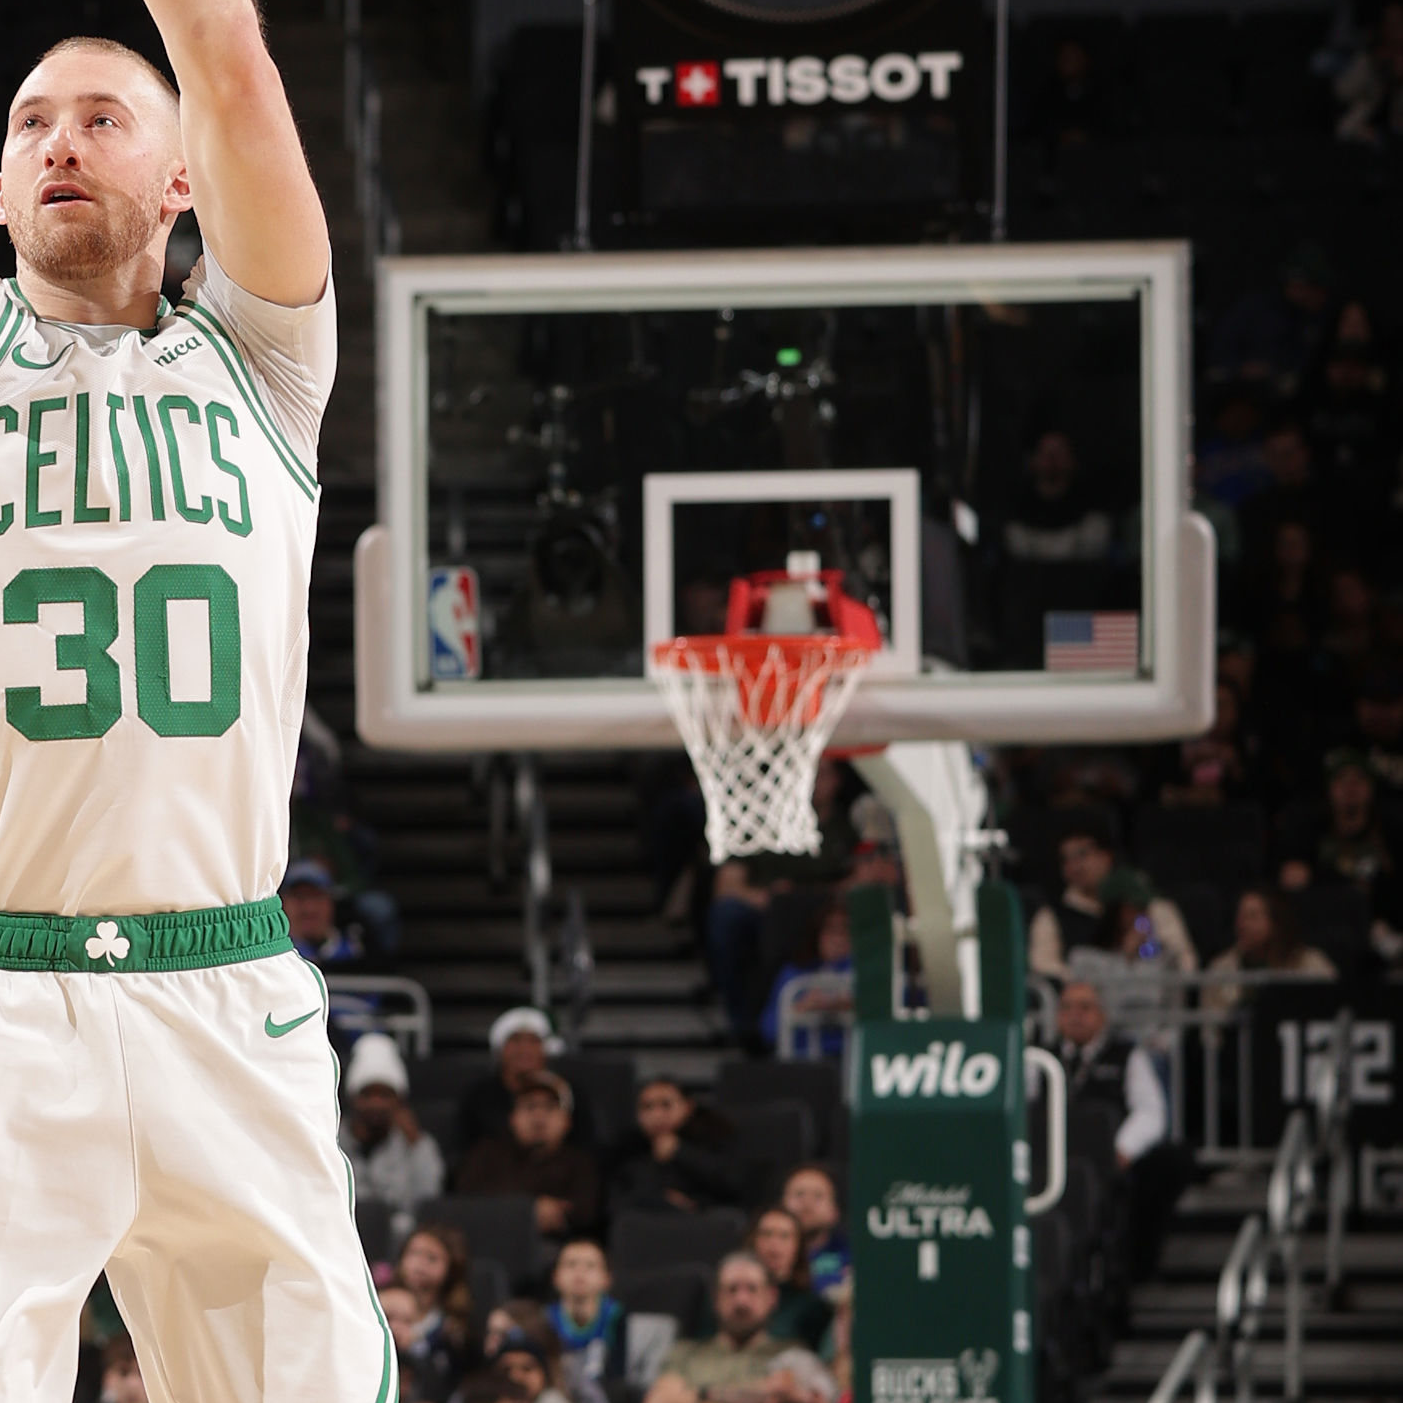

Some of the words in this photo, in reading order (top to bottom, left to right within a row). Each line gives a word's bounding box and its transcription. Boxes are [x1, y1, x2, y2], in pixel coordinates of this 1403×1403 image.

[724, 51, 963, 106] TISSOT
[3, 564, 242, 741] 30
[870, 1040, 1001, 1097] wilo
[867, 1205, 994, 1240] ULTRA
[871, 1365, 959, 1397] BUCKS
